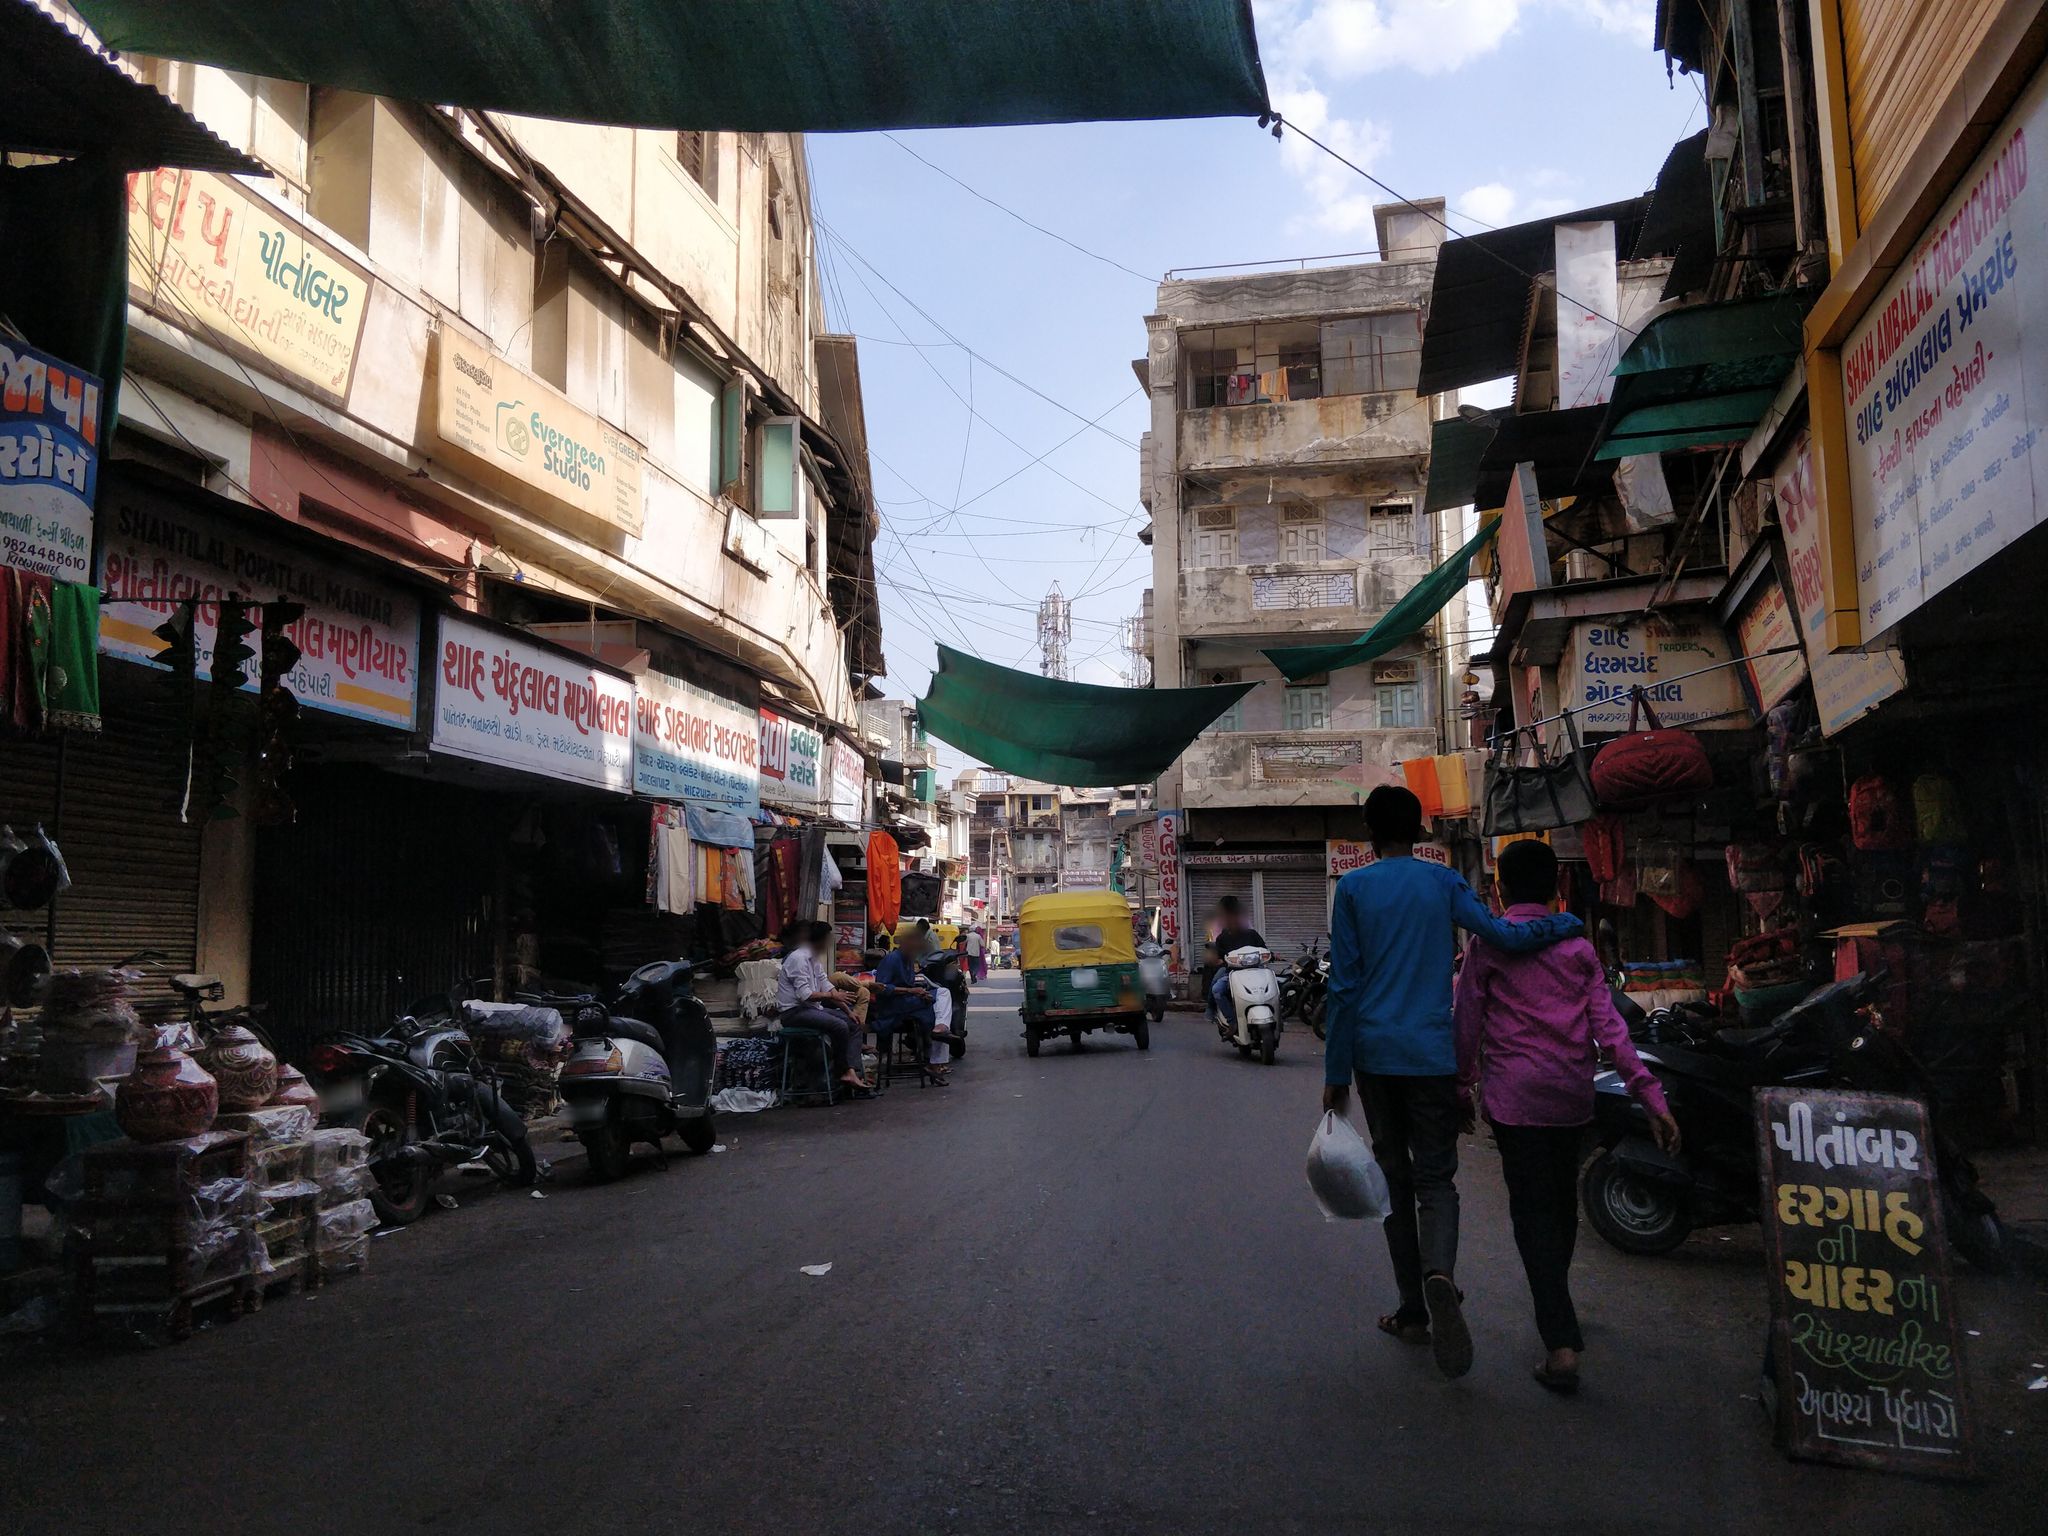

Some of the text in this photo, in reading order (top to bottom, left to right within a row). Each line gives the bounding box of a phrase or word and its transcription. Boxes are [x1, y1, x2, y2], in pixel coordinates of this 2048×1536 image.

[1847, 331, 1876, 406] SHAH
[1877, 260, 1933, 371] AMBALAL
[1932, 127, 2028, 298] PREMCHAND
[1857, 390, 1883, 446] શાહ
[1885, 307, 1953, 412] અંબાલાલ
[1956, 230, 2018, 333] પ્રેમચંદ
[530, 411, 605, 476] Evergreen
[543, 444, 590, 492] Studio
[3, 536, 86, 570] 9824488610
[118, 505, 229, 570] SHANTILAL
[1584, 651, 1659, 673] ધરમચંદ
[1588, 627, 1630, 650] શાહ
[443, 640, 485, 701] શાહ
[491, 649, 560, 715] ચંદુલાલ
[563, 675, 630, 738] મણીલાલ
[637, 696, 661, 741] શાહ
[1336, 843, 1359, 856] શાહ
[1772, 1102, 1919, 1171] પીતાંબર
[1777, 1183, 1923, 1256] દરગાહ
[1816, 1224, 1857, 1264] ની
[1785, 1259, 1940, 1322] ચાદર ના
